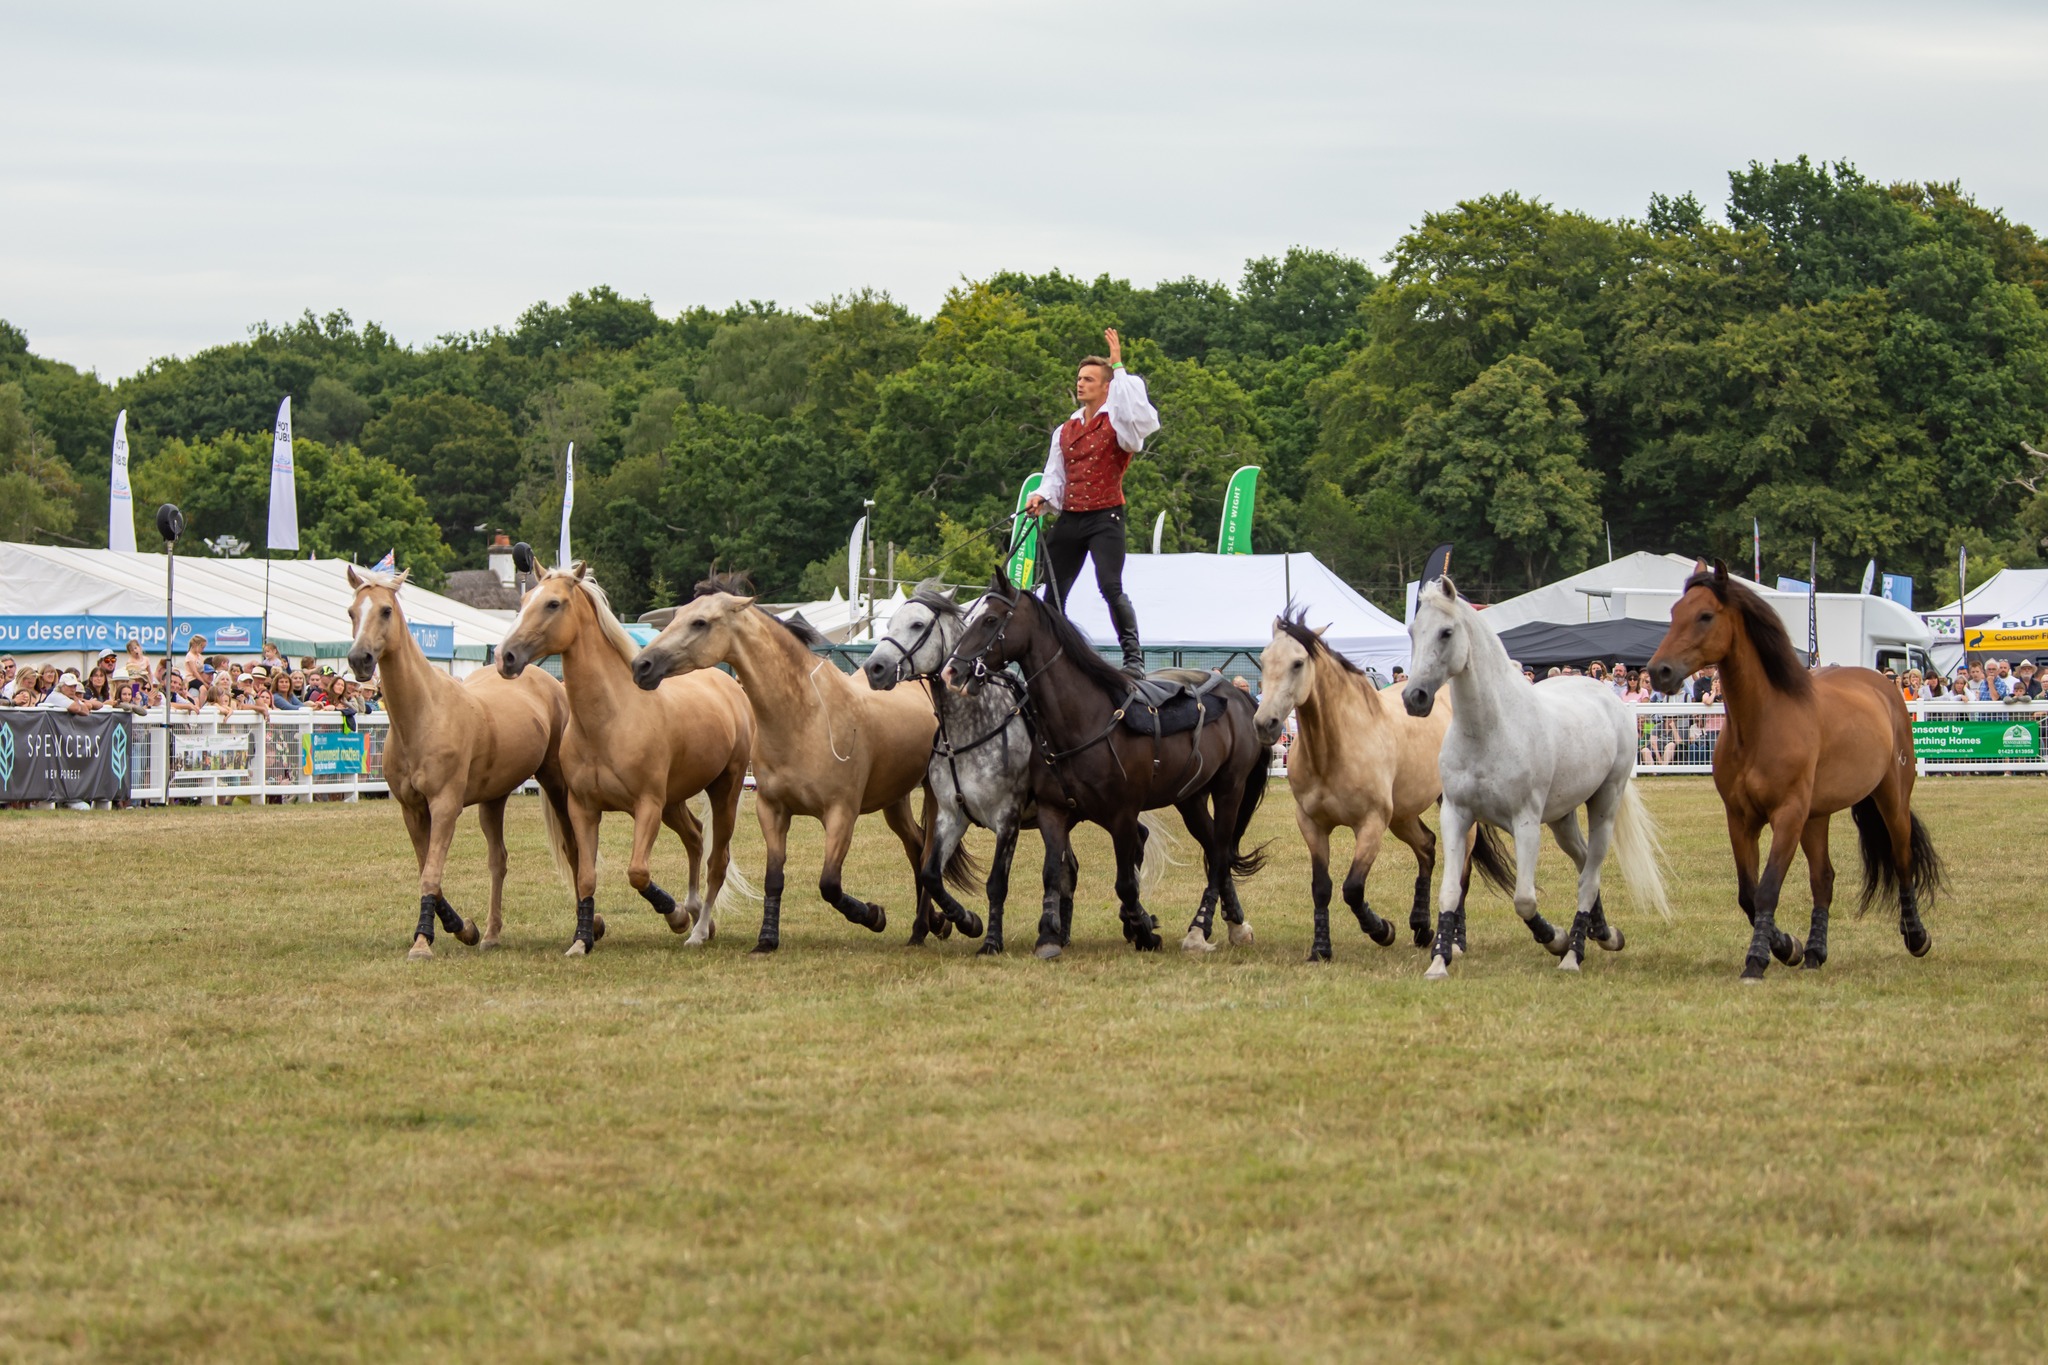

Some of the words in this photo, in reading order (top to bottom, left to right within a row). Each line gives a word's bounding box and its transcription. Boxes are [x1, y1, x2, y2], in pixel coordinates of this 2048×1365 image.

[1231, 486, 1241, 518] WIGHT
[1229, 520, 1236, 533] OF
[1014, 564, 1023, 584] AND
[27, 620, 108, 640] deserve
[1994, 633, 2039, 641] Consumer
[1911, 725, 1949, 734] onsored
[1952, 725, 1963, 735] by
[27, 733, 100, 758] SPENCERS
[1913, 737, 1946, 746] arthing
[1949, 736, 1981, 745] Homes
[44, 769, 57, 779] NEW
[60, 769, 81, 780] FOREST
